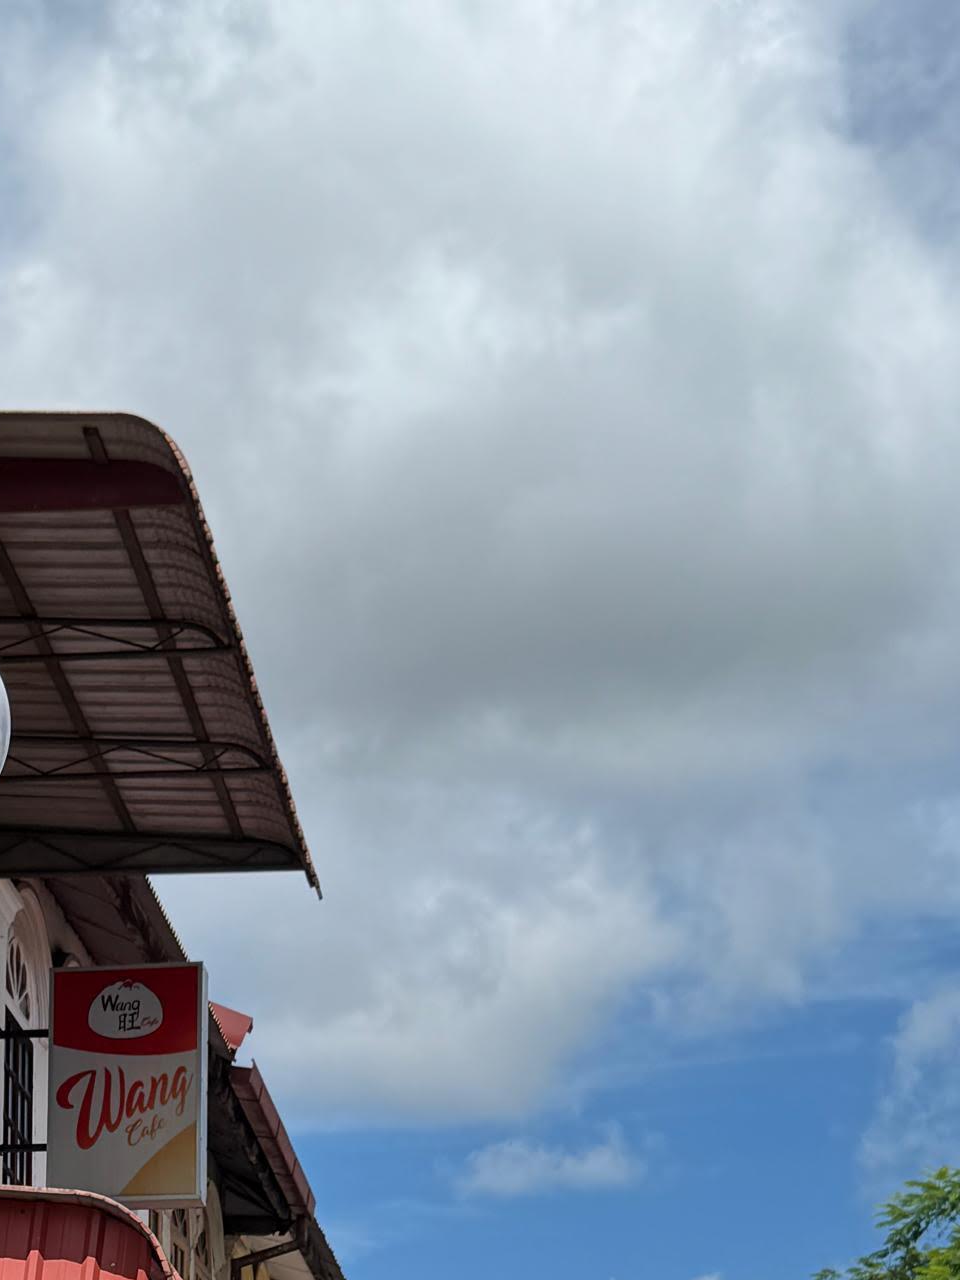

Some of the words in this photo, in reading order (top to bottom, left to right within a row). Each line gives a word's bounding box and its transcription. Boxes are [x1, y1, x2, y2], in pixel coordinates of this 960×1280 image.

[101, 994, 140, 1020] Wang
[118, 1012, 141, 1032] 旺
[56, 1065, 194, 1150] Wang
